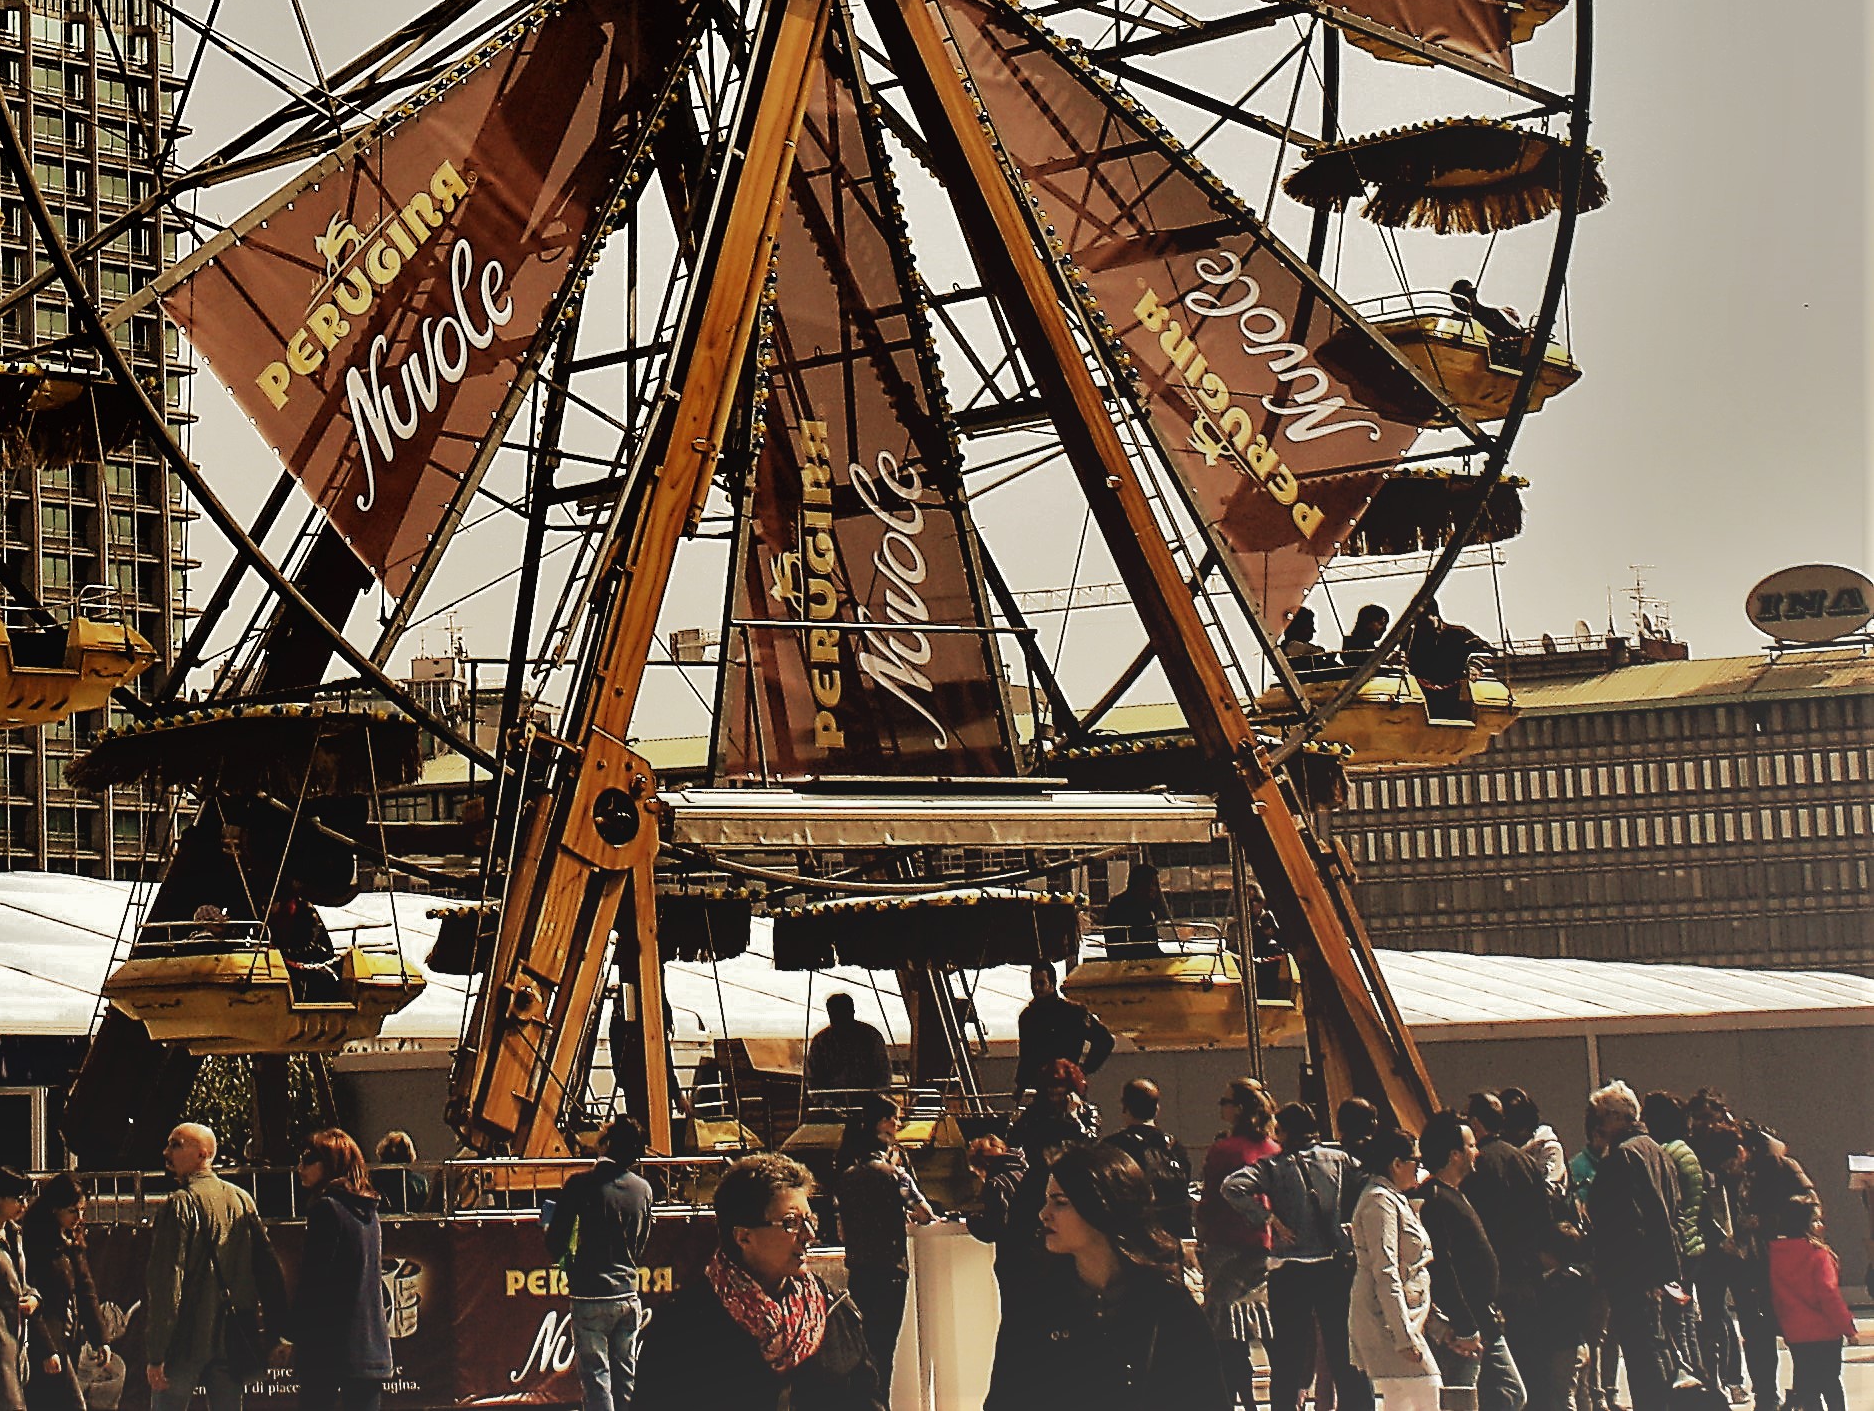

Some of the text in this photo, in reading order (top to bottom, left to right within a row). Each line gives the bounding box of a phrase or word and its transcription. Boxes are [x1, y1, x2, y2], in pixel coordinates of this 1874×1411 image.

[255, 159, 469, 412] PERUGINA
[346, 238, 513, 511] Nuvole
[1184, 250, 1381, 442] Nuvole
[1133, 288, 1326, 539] PERUGINA
[849, 450, 948, 749] Nuvole
[1755, 587, 1869, 622] INA
[268, 1384, 300, 1397] piace
[382, 1380, 421, 1394] ugina.
[505, 1266, 673, 1296] PERNA
